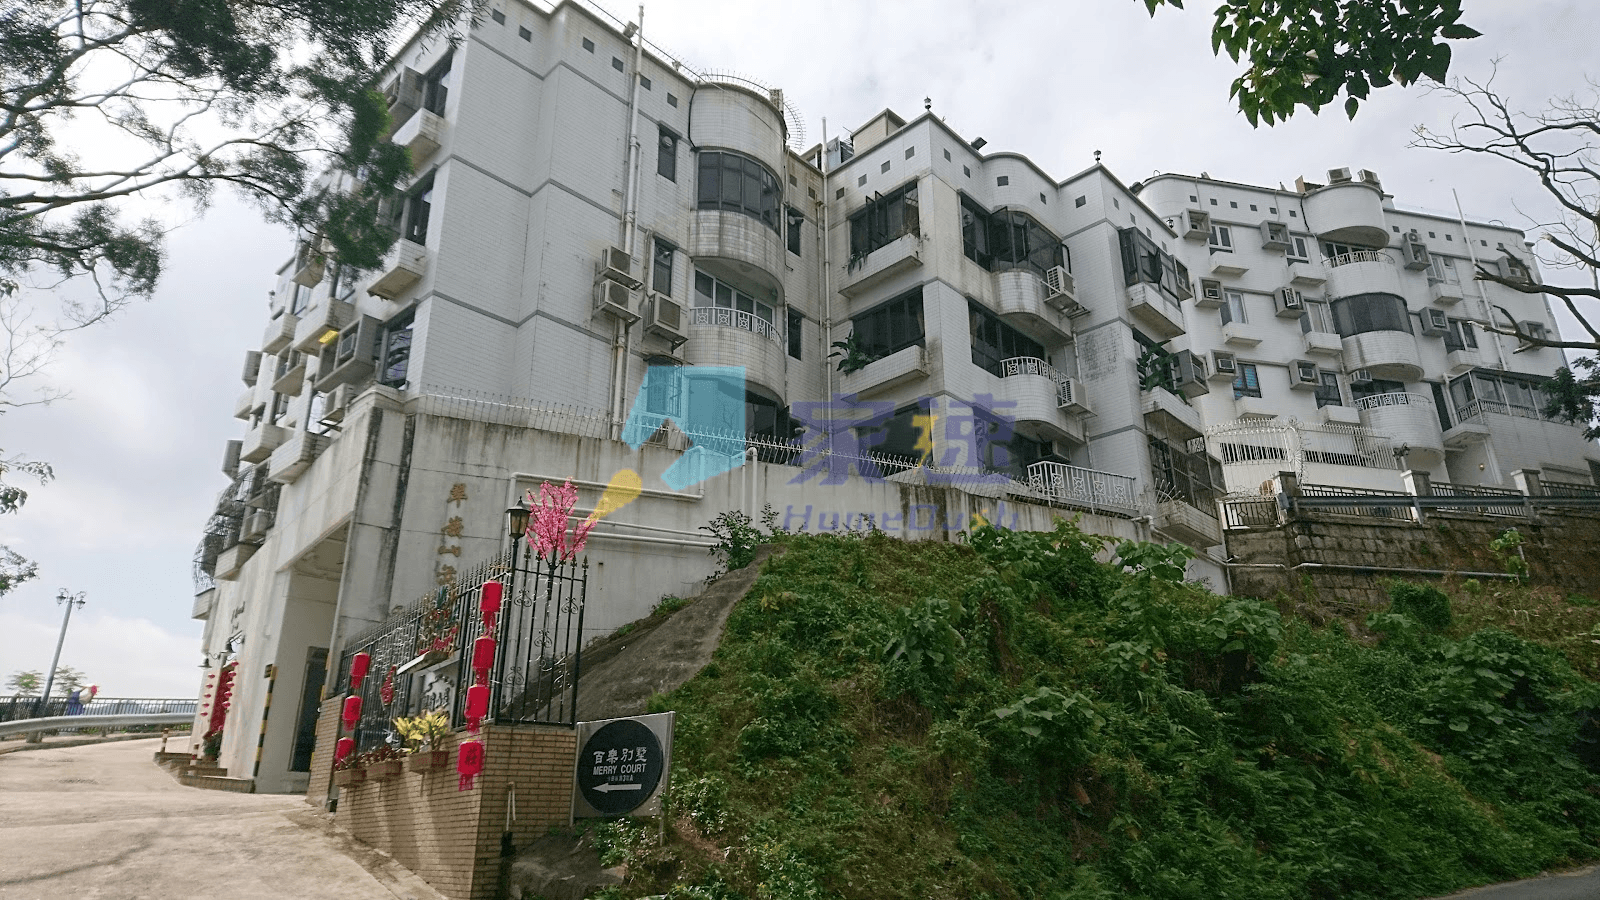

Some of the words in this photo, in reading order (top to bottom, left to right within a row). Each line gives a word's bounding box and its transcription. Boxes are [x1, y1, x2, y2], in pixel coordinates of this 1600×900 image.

[593, 746, 648, 764] 百樂別墅
[592, 765, 618, 776] MERRY
[620, 763, 647, 774] COURT
